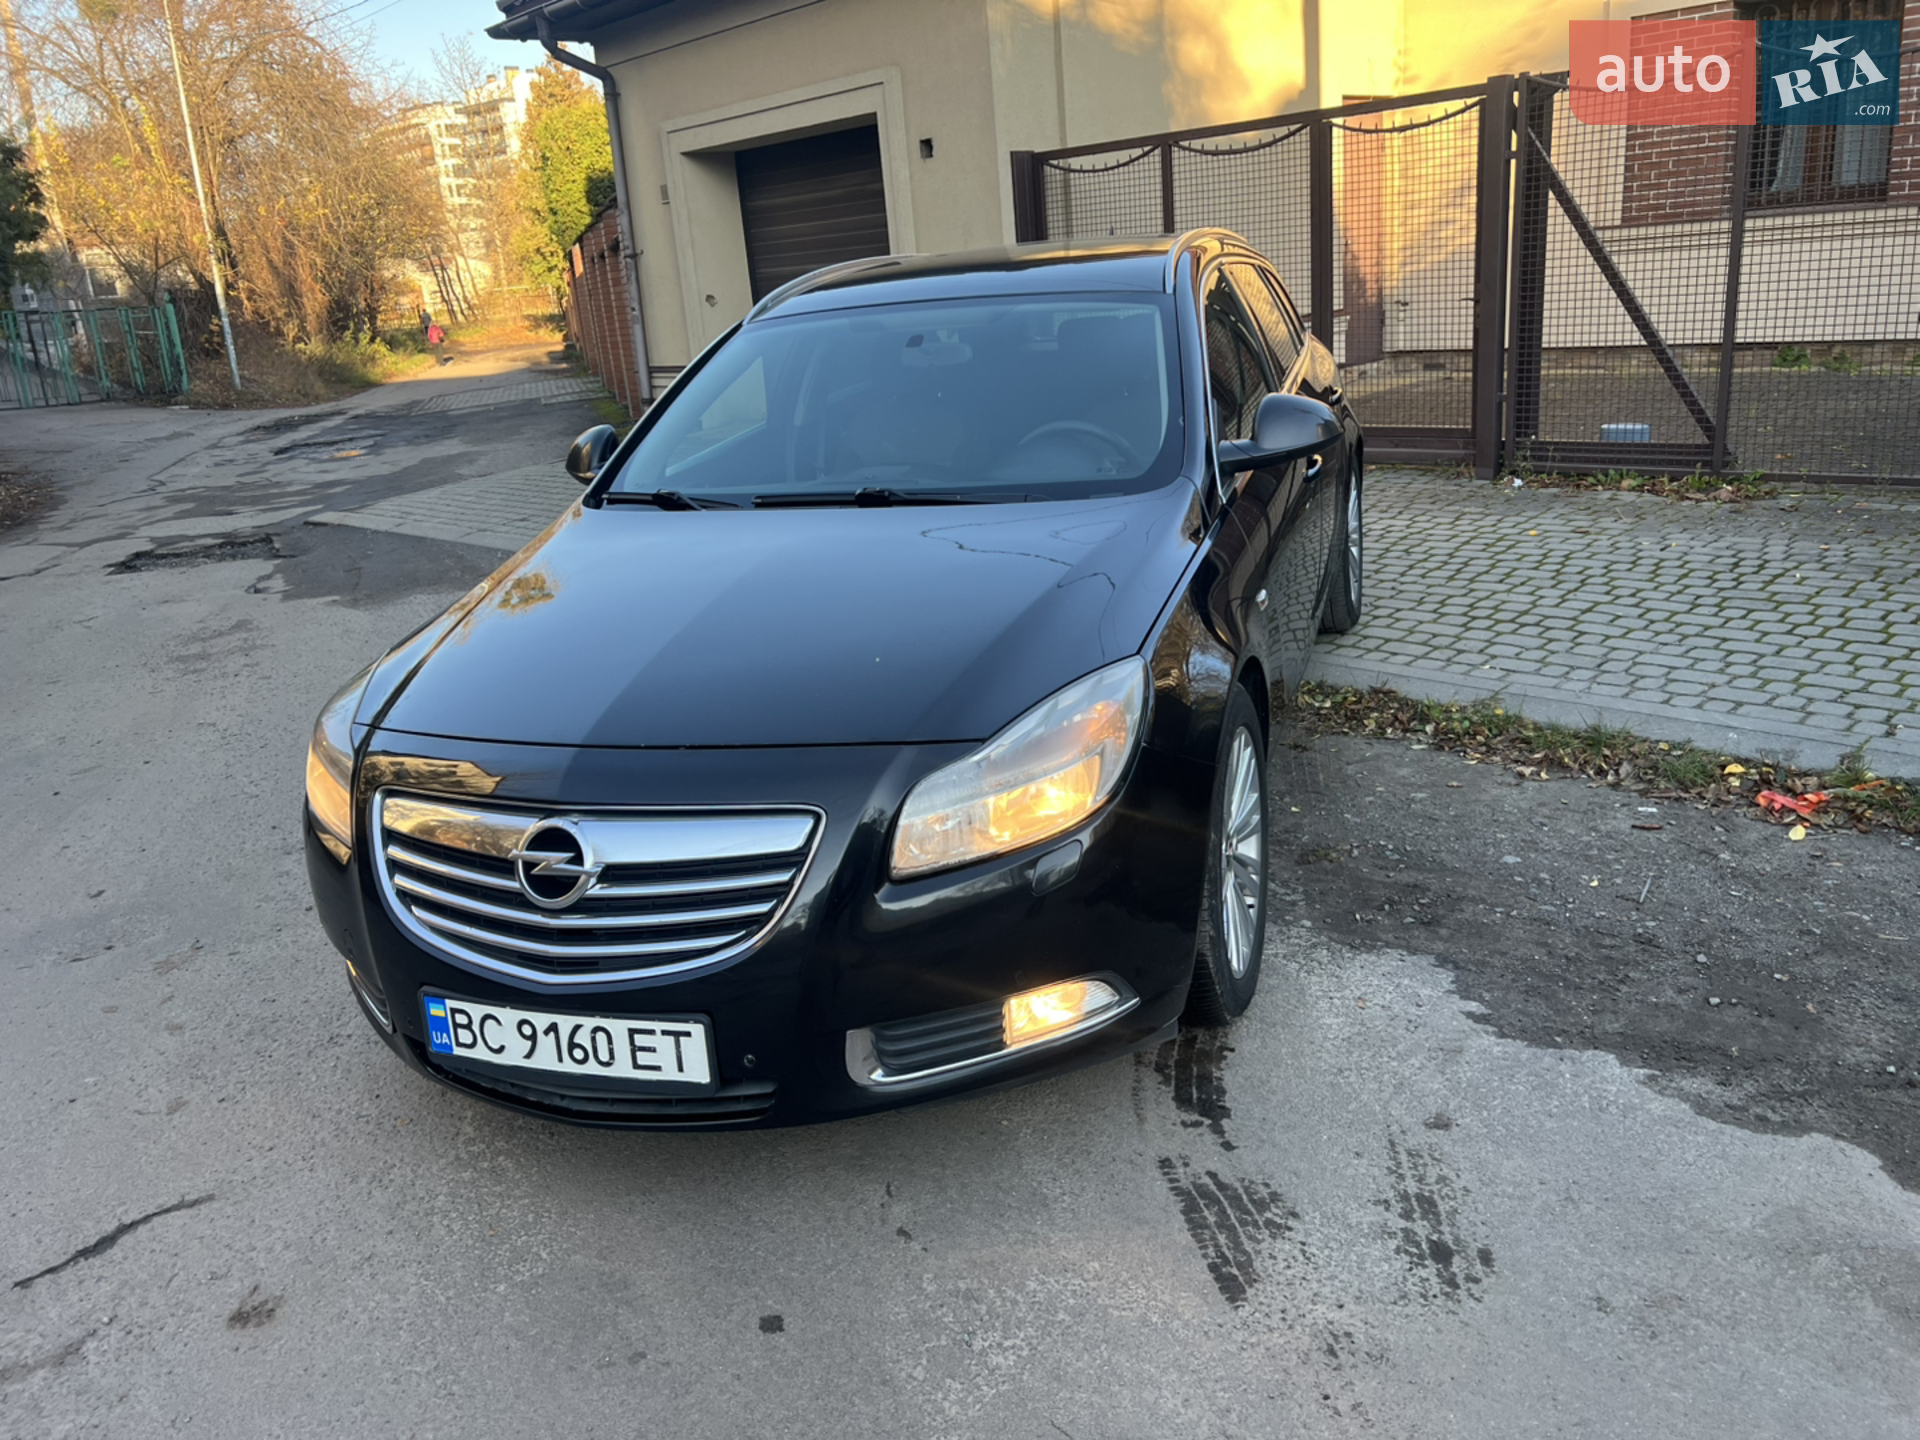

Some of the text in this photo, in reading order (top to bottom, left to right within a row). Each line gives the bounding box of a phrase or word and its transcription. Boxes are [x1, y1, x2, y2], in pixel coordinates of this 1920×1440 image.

[432, 1030, 450, 1045] UA
[450, 1007, 692, 1073] BC 9160 ET
